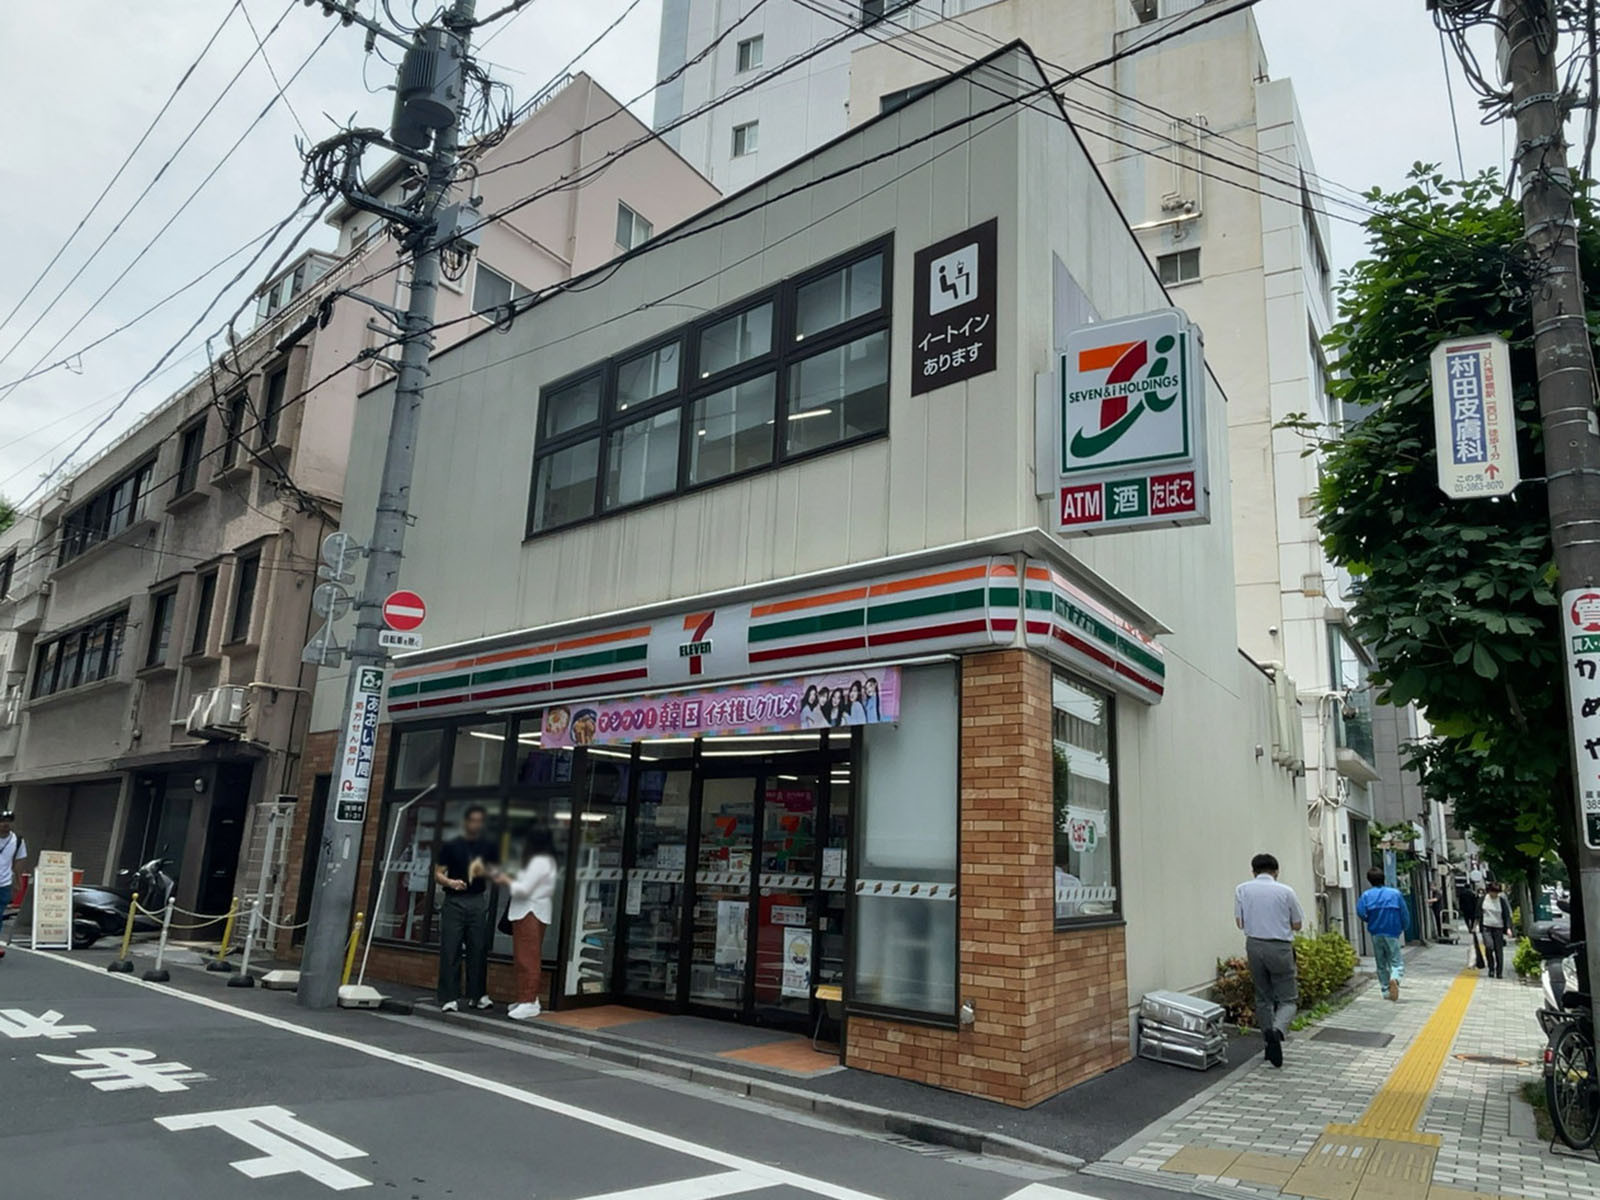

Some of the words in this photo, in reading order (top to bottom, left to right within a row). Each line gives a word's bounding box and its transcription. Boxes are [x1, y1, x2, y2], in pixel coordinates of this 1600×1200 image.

[918, 314, 990, 351] イートイン
[923, 342, 983, 376] あります
[1119, 375, 1179, 395] HOLDINGS
[1450, 355, 1484, 462] 村田皮膚科
[1064, 490, 1100, 520] ATM
[1113, 485, 1139, 515] 酒
[1152, 479, 1193, 510] たばこ
[679, 640, 712, 657] ELEVEN
